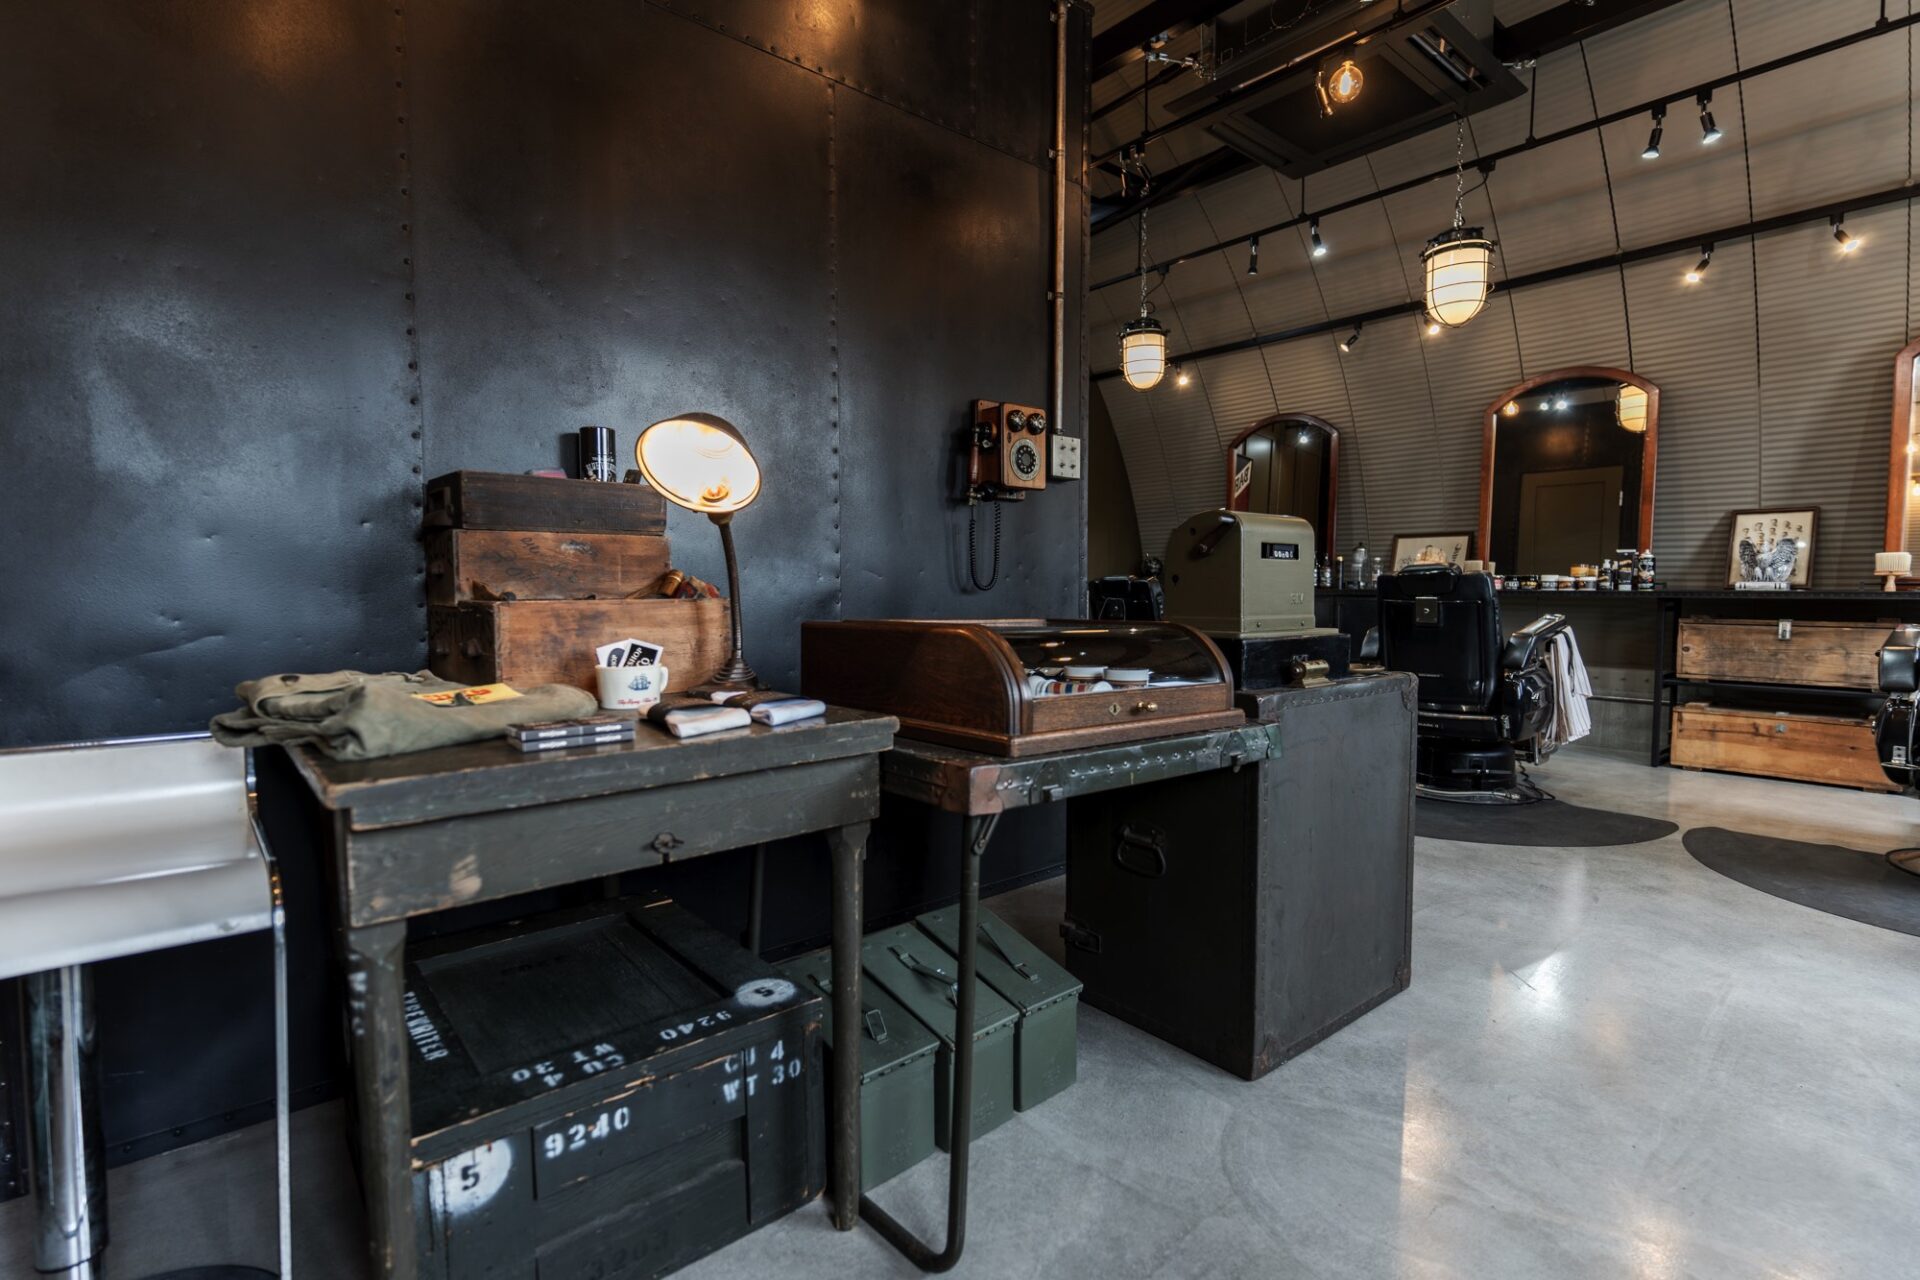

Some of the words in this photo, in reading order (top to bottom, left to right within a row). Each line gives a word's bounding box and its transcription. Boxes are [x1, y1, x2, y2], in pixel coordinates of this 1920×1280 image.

[754, 986, 775, 998] 5
[659, 1010, 733, 1040] 9240
[724, 1047, 756, 1074] CU
[770, 1039, 784, 1060] 4
[722, 1074, 758, 1103] WT
[771, 1059, 802, 1085] 30
[544, 1106, 631, 1159] 9240
[461, 1164, 480, 1191] 5
